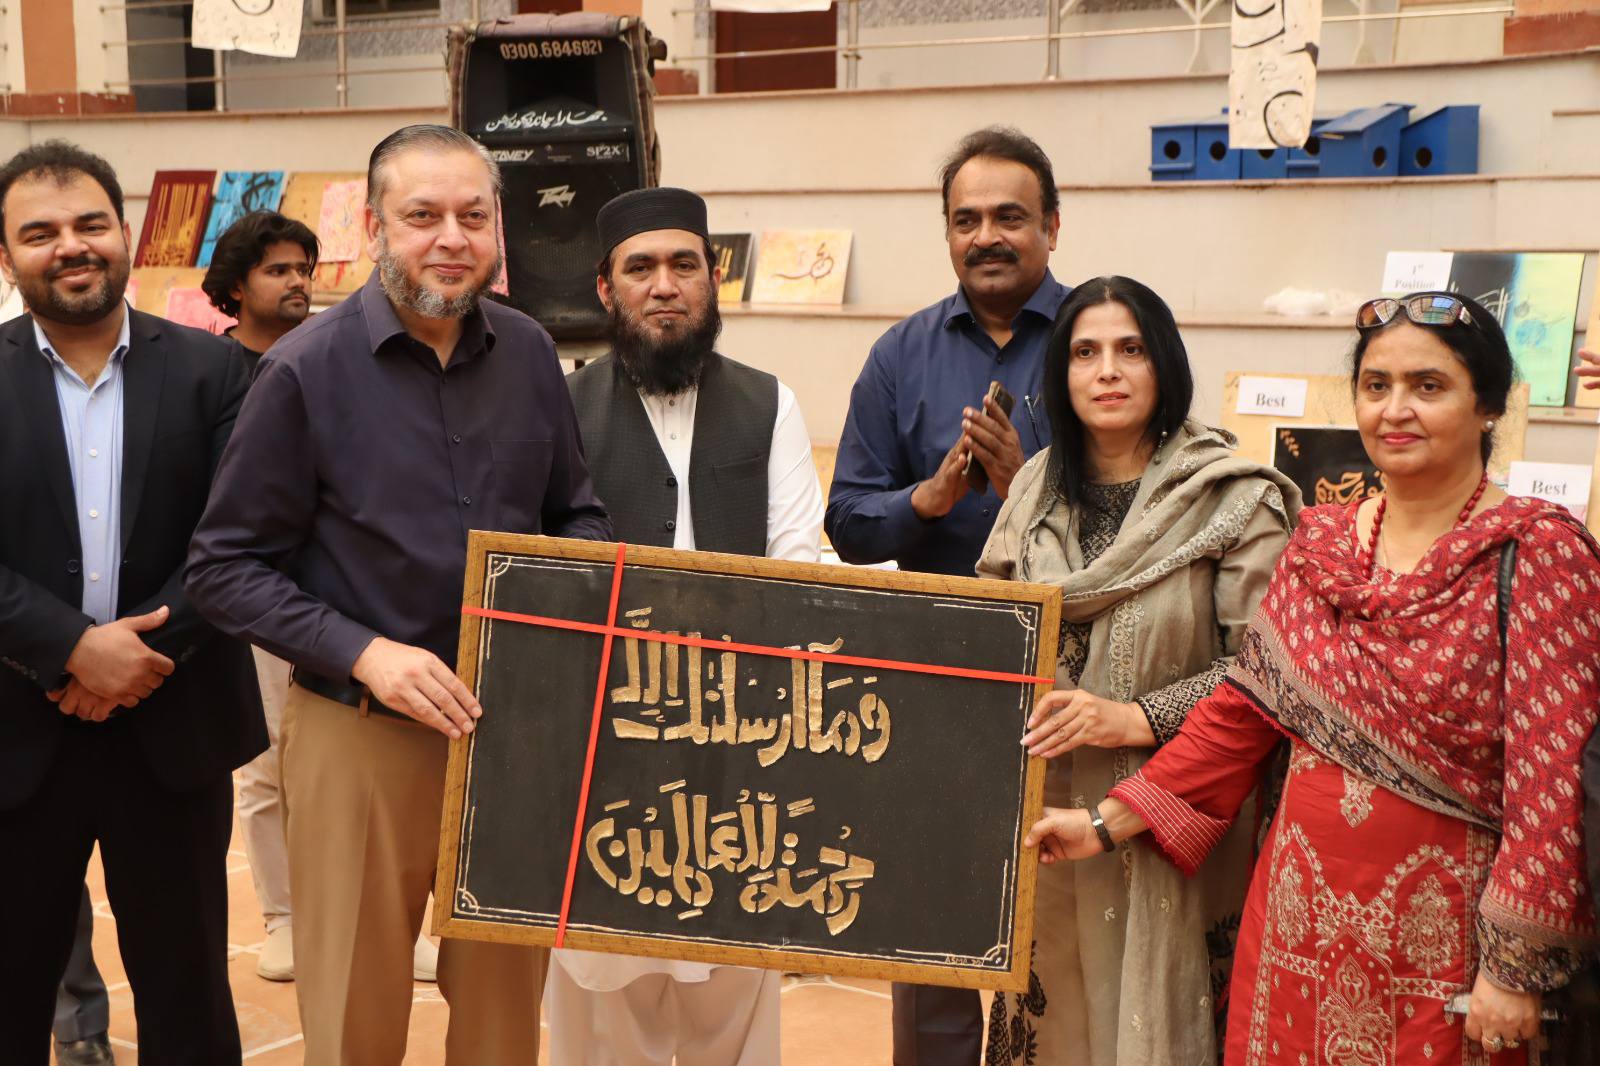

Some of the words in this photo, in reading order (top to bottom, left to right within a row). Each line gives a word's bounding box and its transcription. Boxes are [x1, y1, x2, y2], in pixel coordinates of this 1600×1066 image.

[500, 40, 602, 59] 0300.6846821
[1394, 279, 1436, 289] Position
[1256, 392, 1286, 408] Best
[1532, 480, 1567, 495] Best
